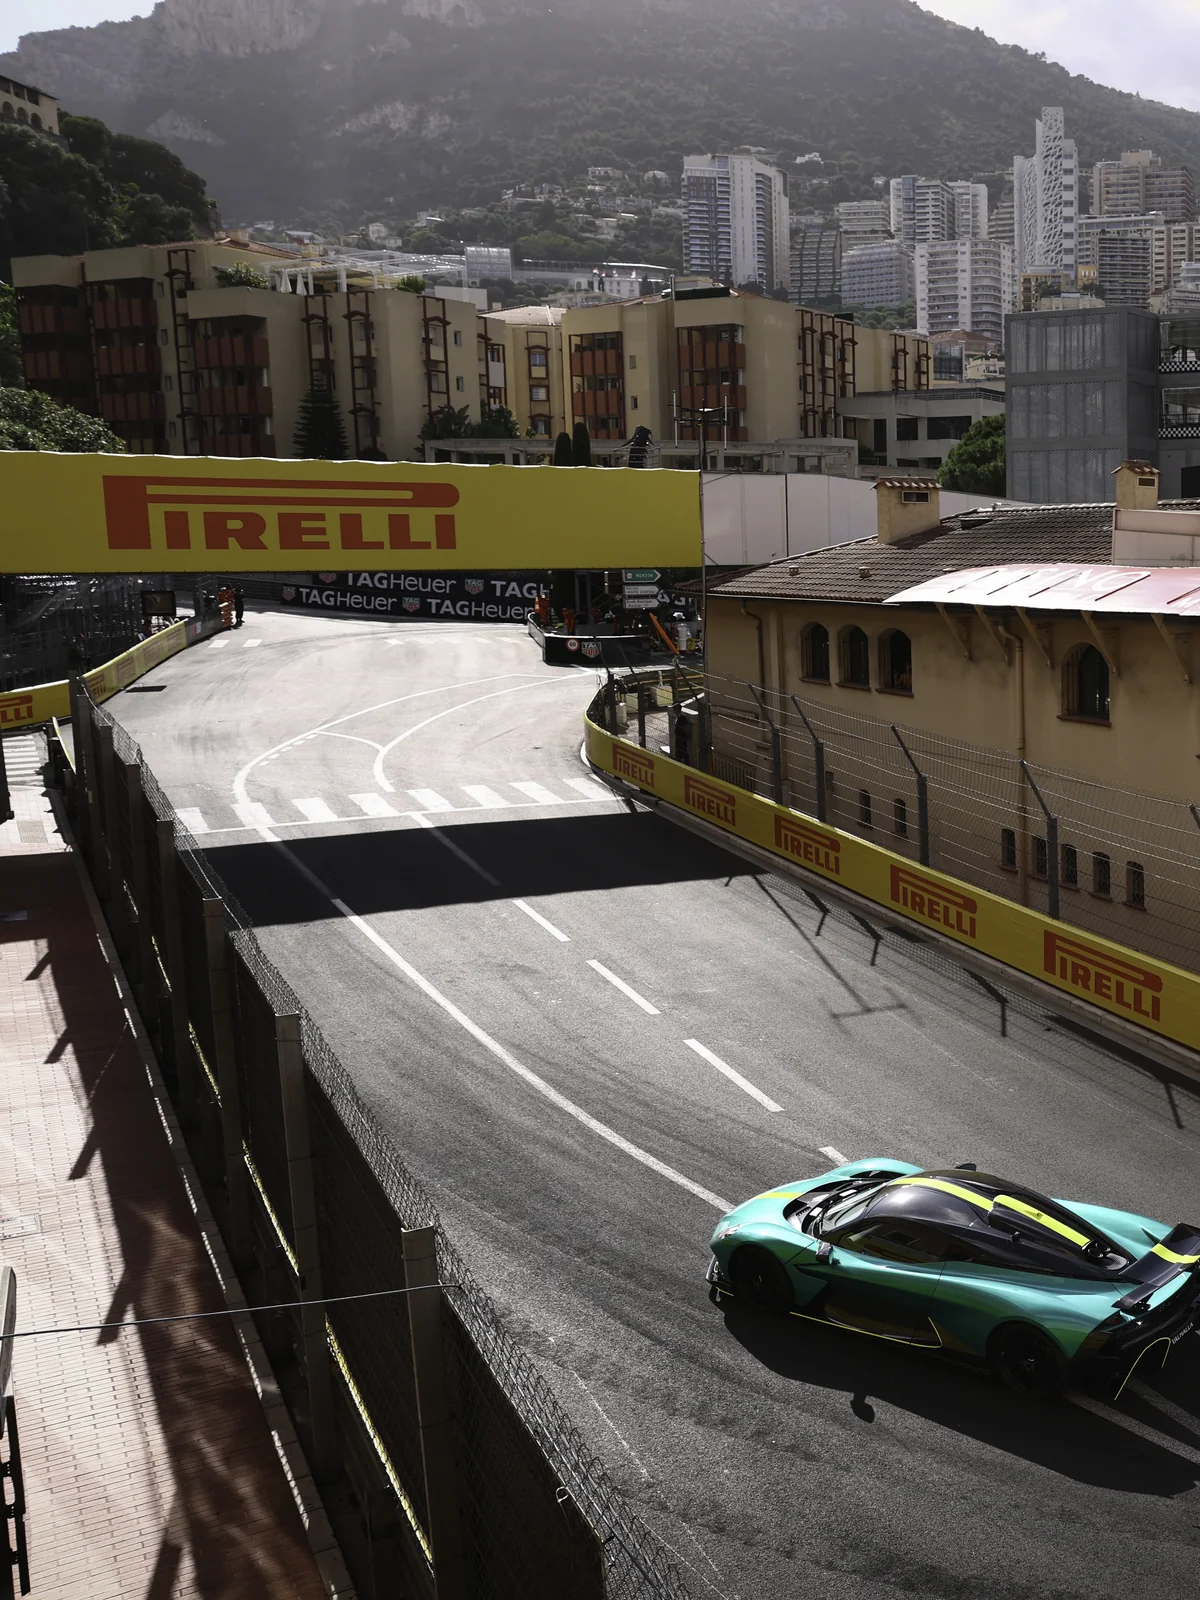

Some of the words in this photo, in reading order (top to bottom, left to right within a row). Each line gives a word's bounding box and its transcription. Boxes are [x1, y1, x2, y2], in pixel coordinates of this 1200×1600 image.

[103, 475, 460, 550] PIRELLI
[612, 743, 655, 788] PIRELLI
[684, 774, 736, 826] PIRELLI
[774, 814, 841, 876] PIRELLI
[890, 863, 978, 941] PIRELLI
[1043, 929, 1163, 1023] PIRELLI
